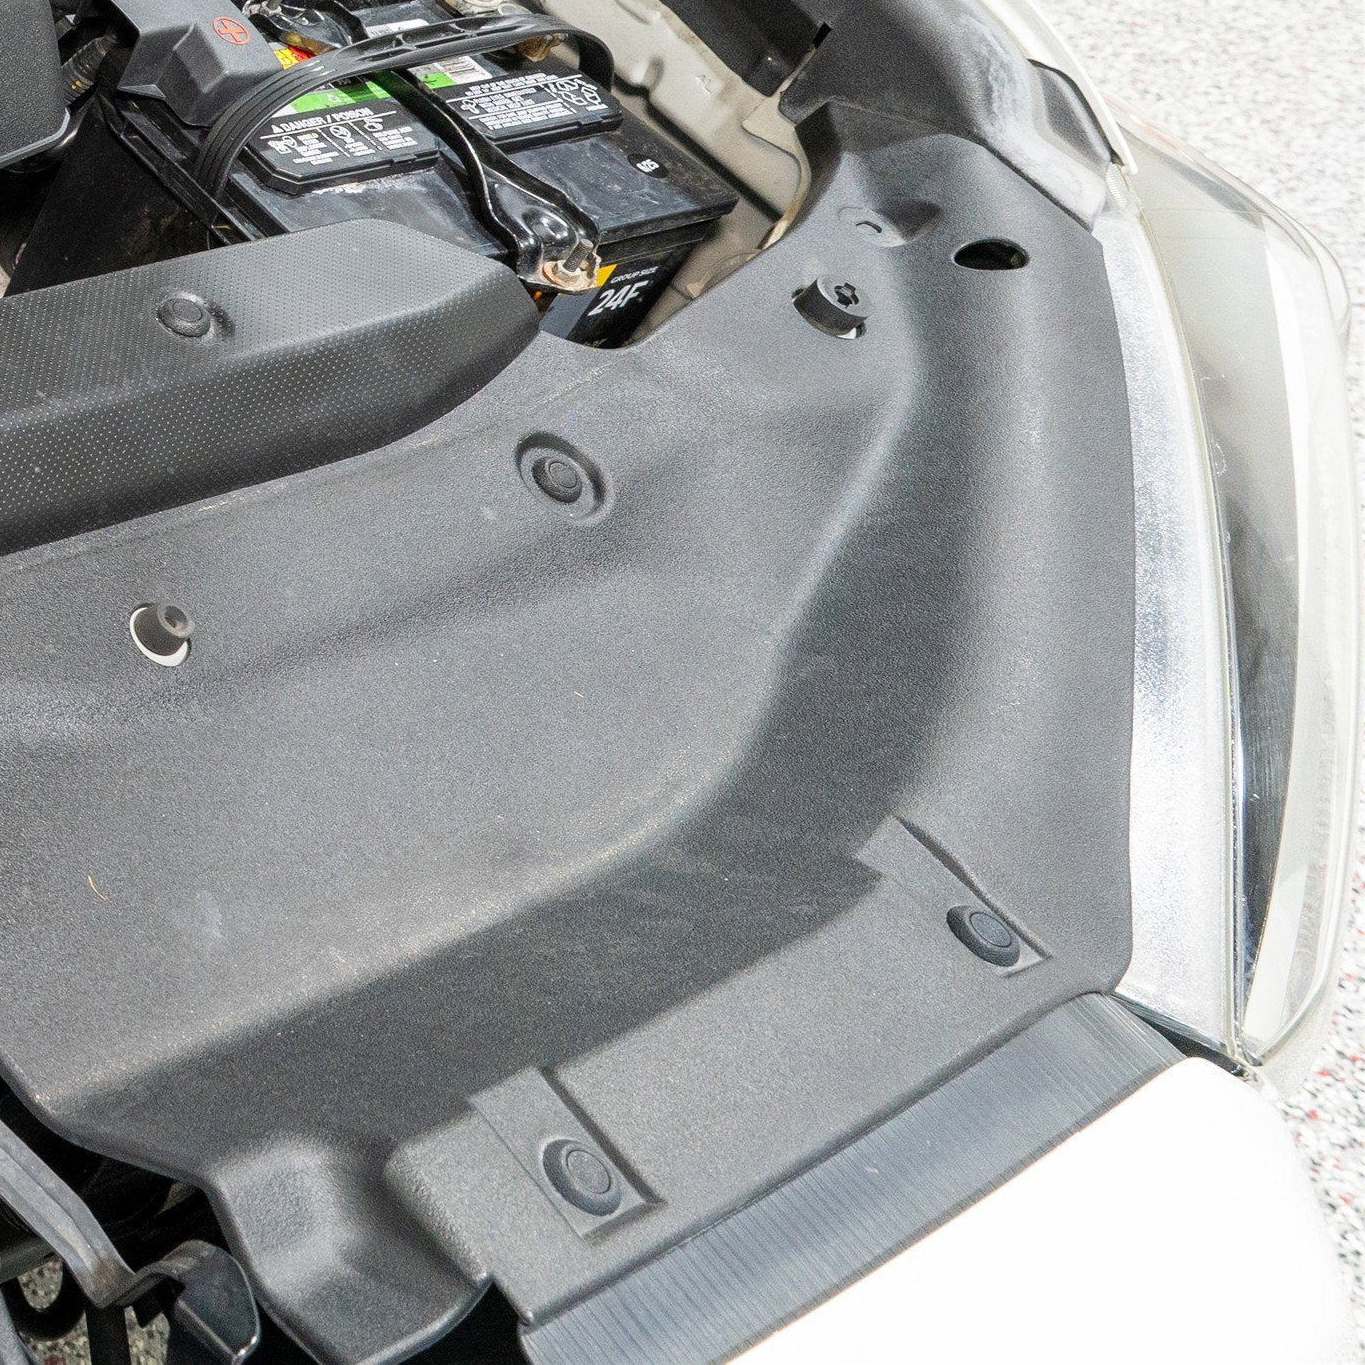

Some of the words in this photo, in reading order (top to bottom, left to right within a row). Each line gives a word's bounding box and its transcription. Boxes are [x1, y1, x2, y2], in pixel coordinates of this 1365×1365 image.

[279, 116, 327, 132] DANGER
[333, 107, 375, 122] POISON
[610, 271, 640, 284] GROUP
[639, 266, 660, 277] SIZE
[587, 280, 650, 317] 24F
